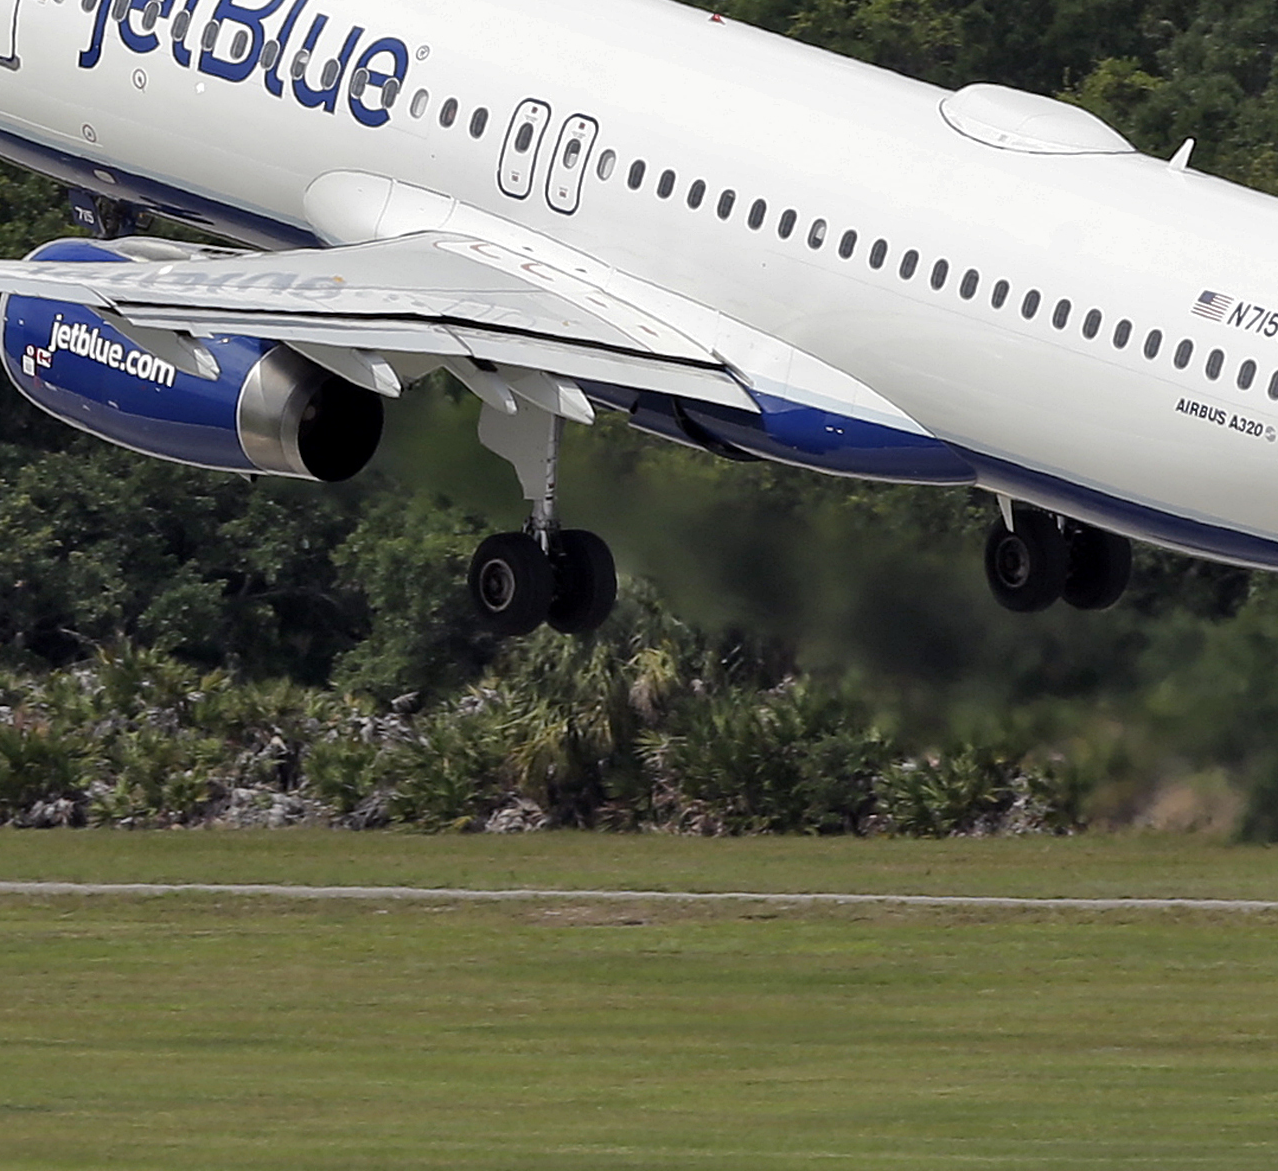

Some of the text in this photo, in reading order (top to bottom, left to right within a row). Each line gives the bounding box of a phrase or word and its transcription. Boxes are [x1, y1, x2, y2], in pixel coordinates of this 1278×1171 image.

[74, 205, 95, 224] 715
[48, 314, 175, 387] jetblue.com
[1175, 398, 1264, 437] AIRBUS A320
